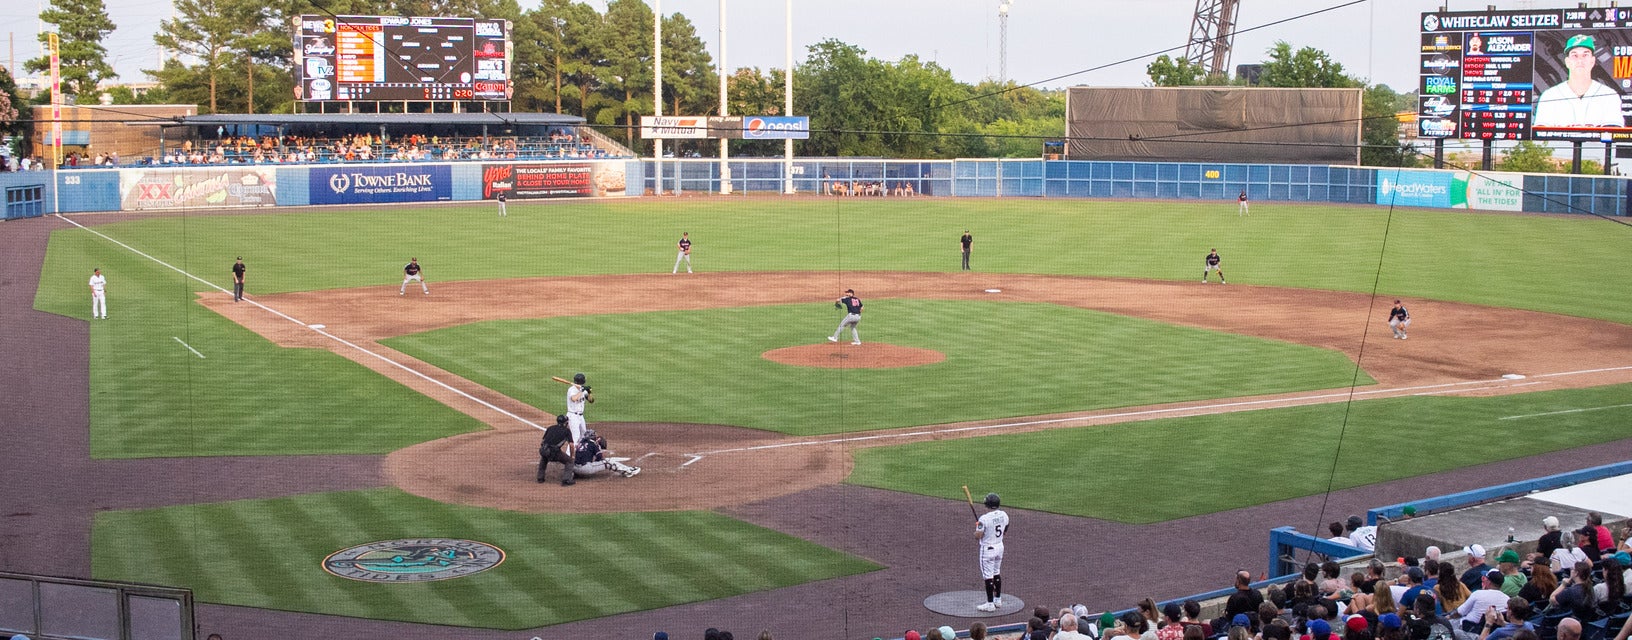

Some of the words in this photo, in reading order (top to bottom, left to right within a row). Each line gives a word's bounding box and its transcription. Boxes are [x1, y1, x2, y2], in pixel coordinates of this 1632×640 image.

[410, 18, 433, 27] JONES
[1441, 16, 1510, 28] WHITECLAW
[1511, 14, 1559, 27] SELTZER
[303, 21, 325, 29] NEWS
[324, 19, 335, 33] 3
[1488, 37, 1514, 45] JASON
[1487, 44, 1531, 52] ALEXANDER
[1426, 77, 1456, 85] ROYAL
[475, 83, 504, 92] Canon
[1426, 85, 1456, 93] FARMS
[654, 118, 679, 127] Navy
[661, 127, 696, 135] Mutual
[767, 121, 802, 135] pepsi
[65, 176, 80, 184] 333
[138, 183, 173, 201] XX
[174, 173, 229, 204] CANTINA
[1389, 182, 1446, 194] HeadWaters
[1494, 198, 1517, 206] TIDES!
[995, 525, 1002, 538] 5
